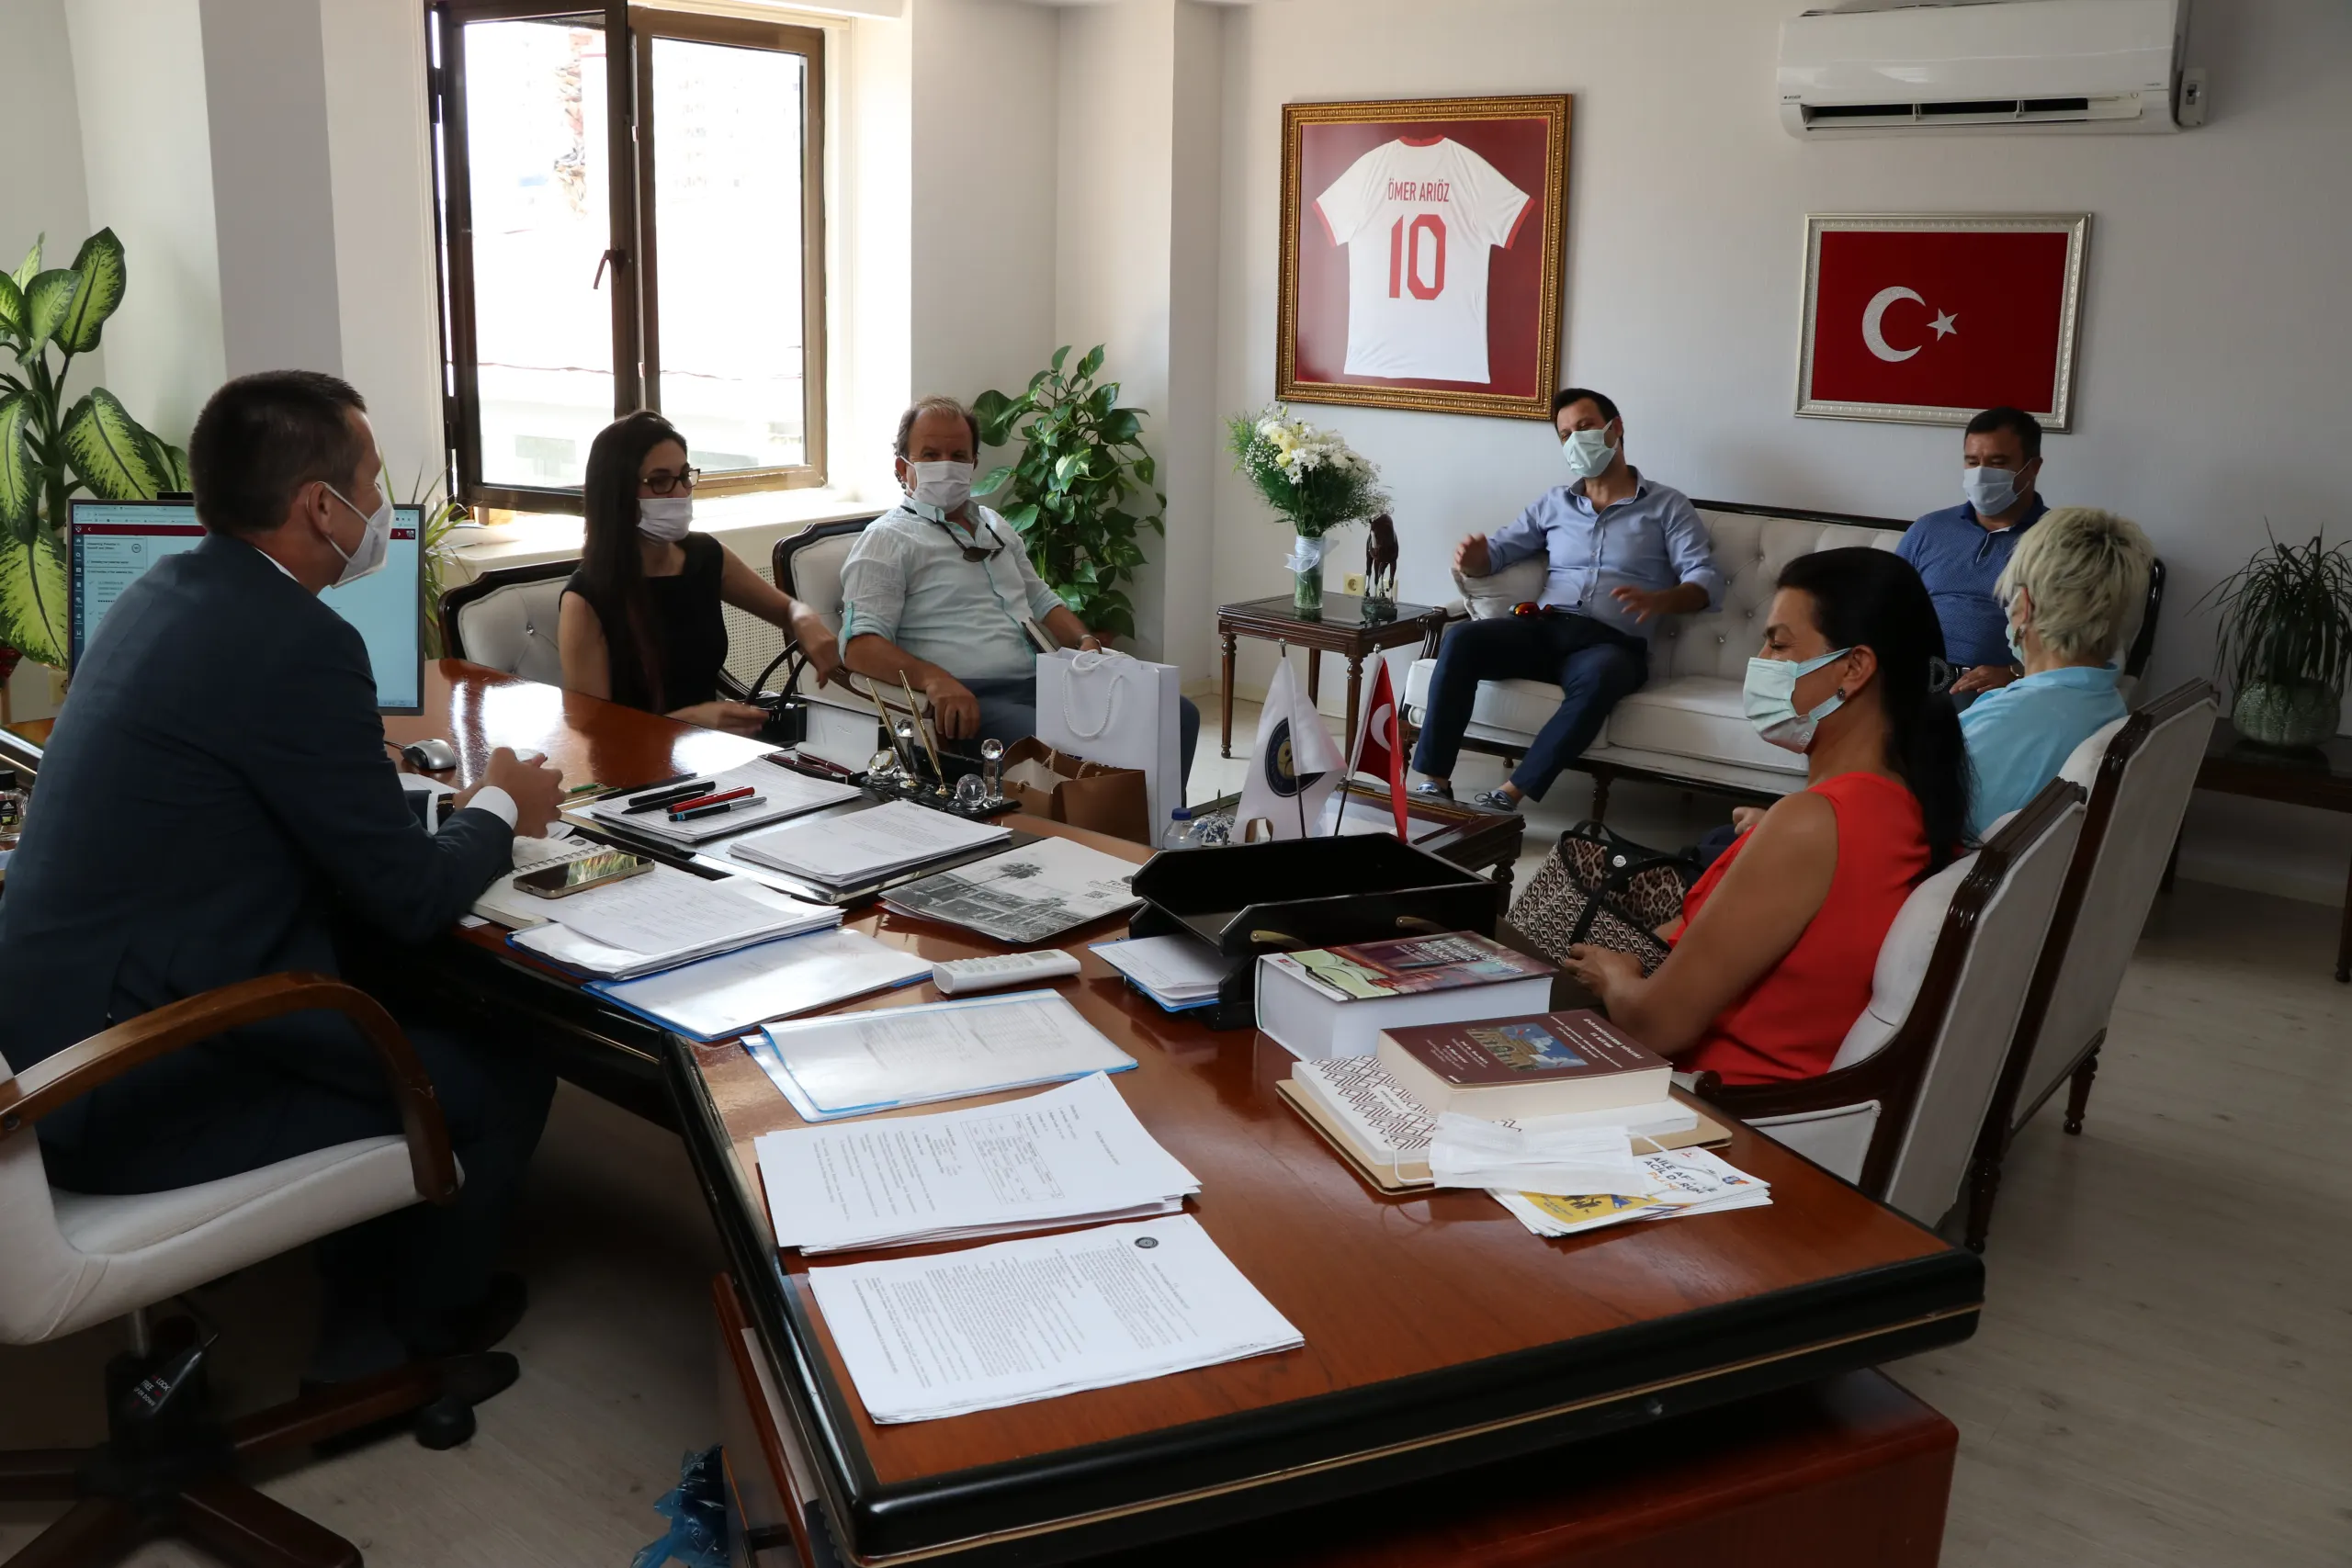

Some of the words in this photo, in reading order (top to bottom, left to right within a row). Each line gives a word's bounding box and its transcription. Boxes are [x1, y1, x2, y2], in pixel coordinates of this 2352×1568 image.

[1387, 177, 1417, 201] ÖMER
[1388, 214, 1447, 300] 10
[1643, 1160, 1667, 1175] ACİL
[1650, 1157, 1676, 1170] AİLE
[141, 1380, 154, 1391] FREE
[156, 1378, 171, 1391] LOCK
